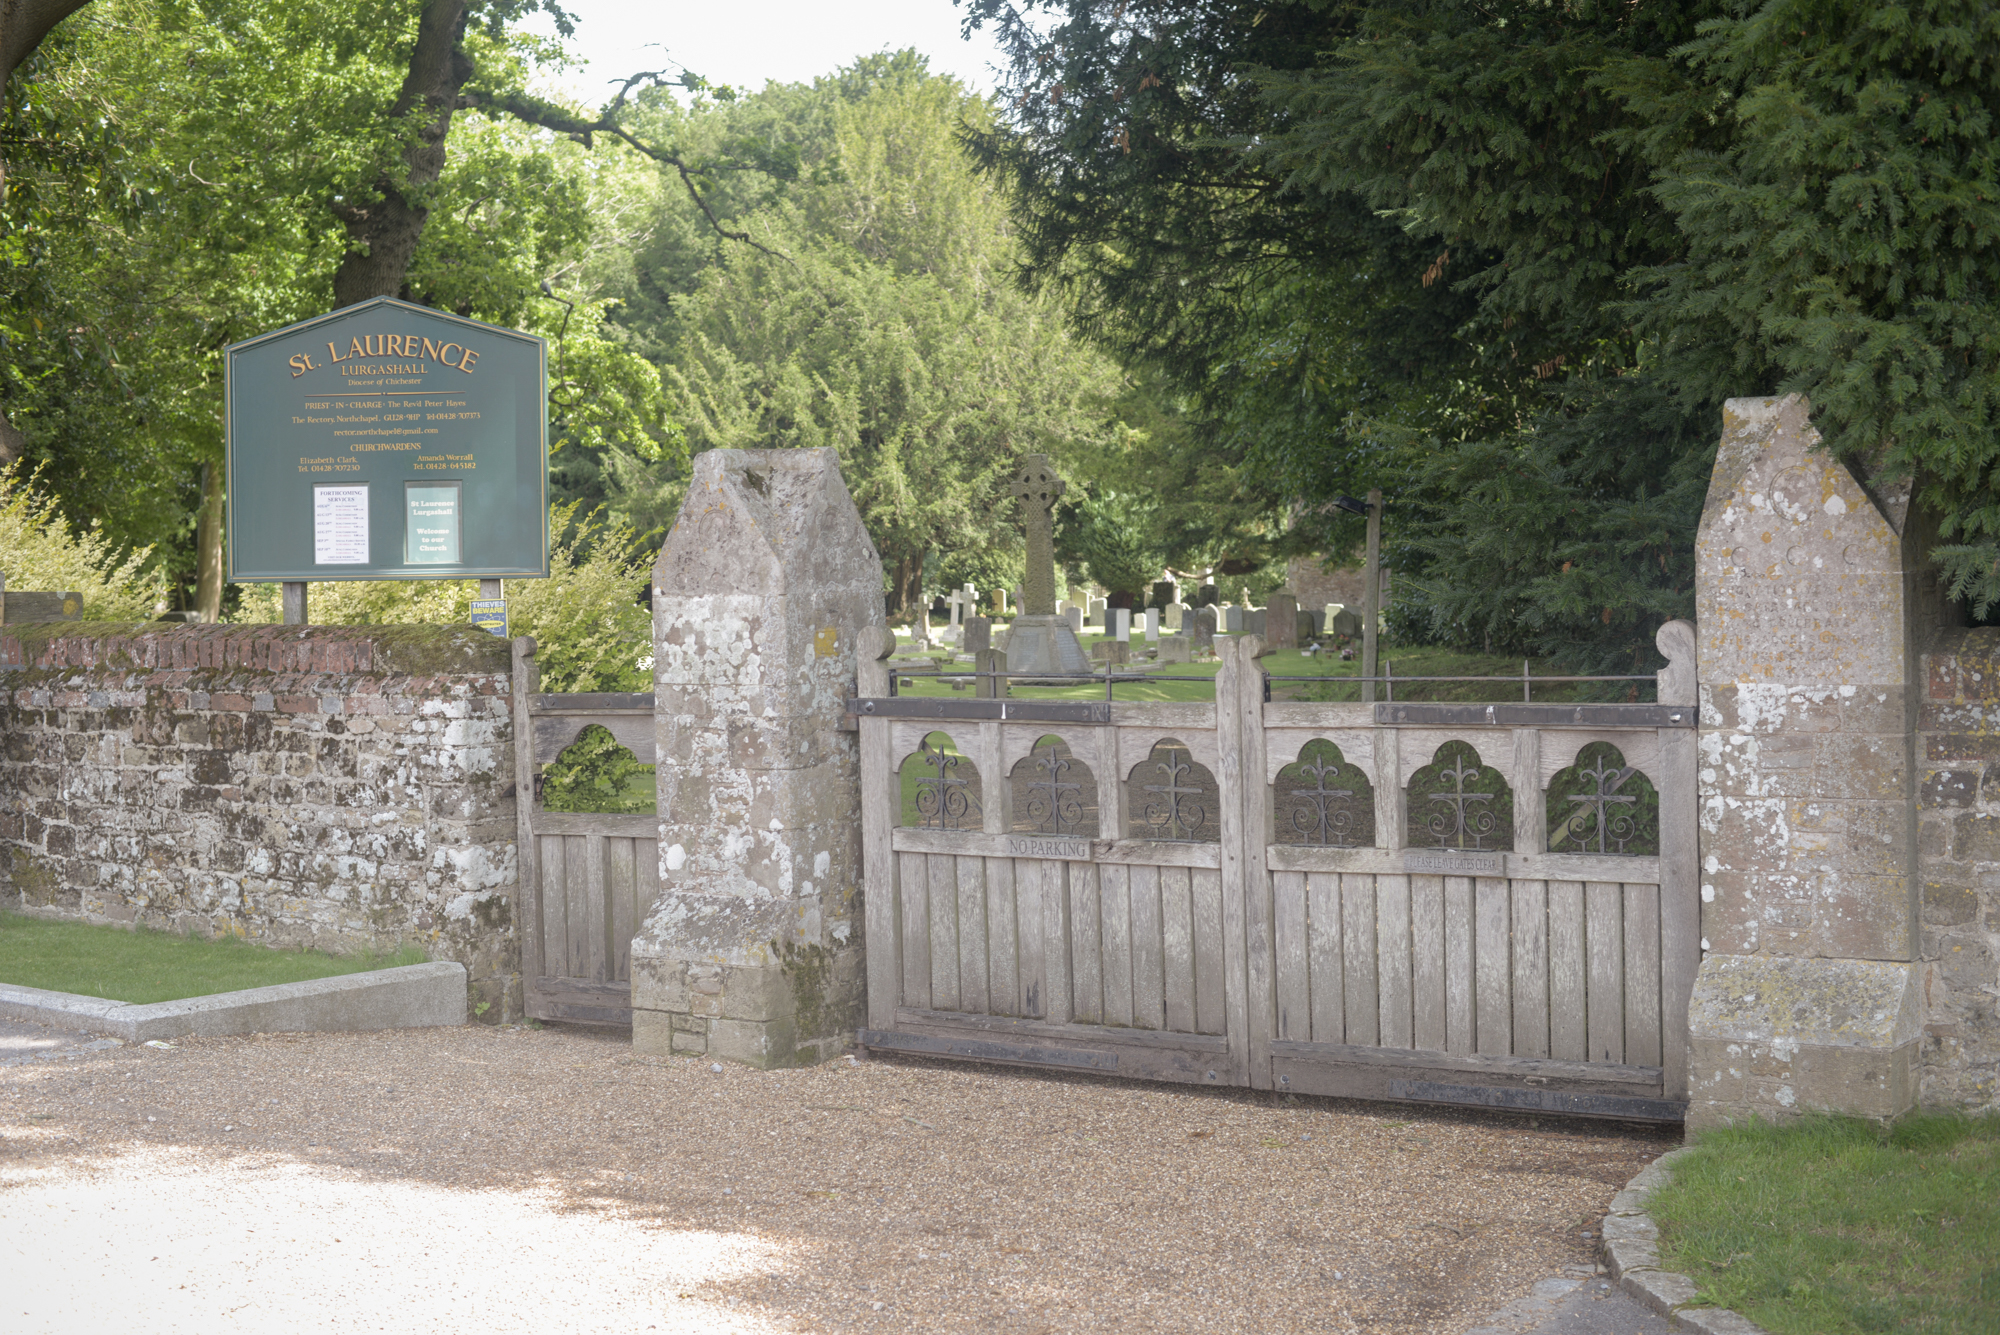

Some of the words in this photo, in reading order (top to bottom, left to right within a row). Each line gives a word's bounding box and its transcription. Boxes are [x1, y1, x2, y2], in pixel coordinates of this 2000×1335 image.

[289, 353, 322, 378] St.
[327, 333, 480, 375] LAURENCE
[341, 363, 428, 376] LURGASHALL
[376, 378, 383, 387] of
[386, 378, 422, 386] Chichester
[388, 400, 401, 408] The
[446, 400, 466, 409] Hayes
[292, 416, 305, 424] The
[350, 442, 421, 452] CHURCHWARDENS
[300, 456, 335, 464] Elizabeth
[417, 454, 445, 462] Amanda
[446, 453, 474, 461] Worrall
[413, 508, 453, 516] Lurgashall
[1009, 839, 1028, 855] NO
[1030, 840, 1086, 858] PARKING
[1409, 855, 1433, 868] PLEASE
[1433, 856, 1454, 869] LEAVE
[1454, 857, 1475, 870] GATES
